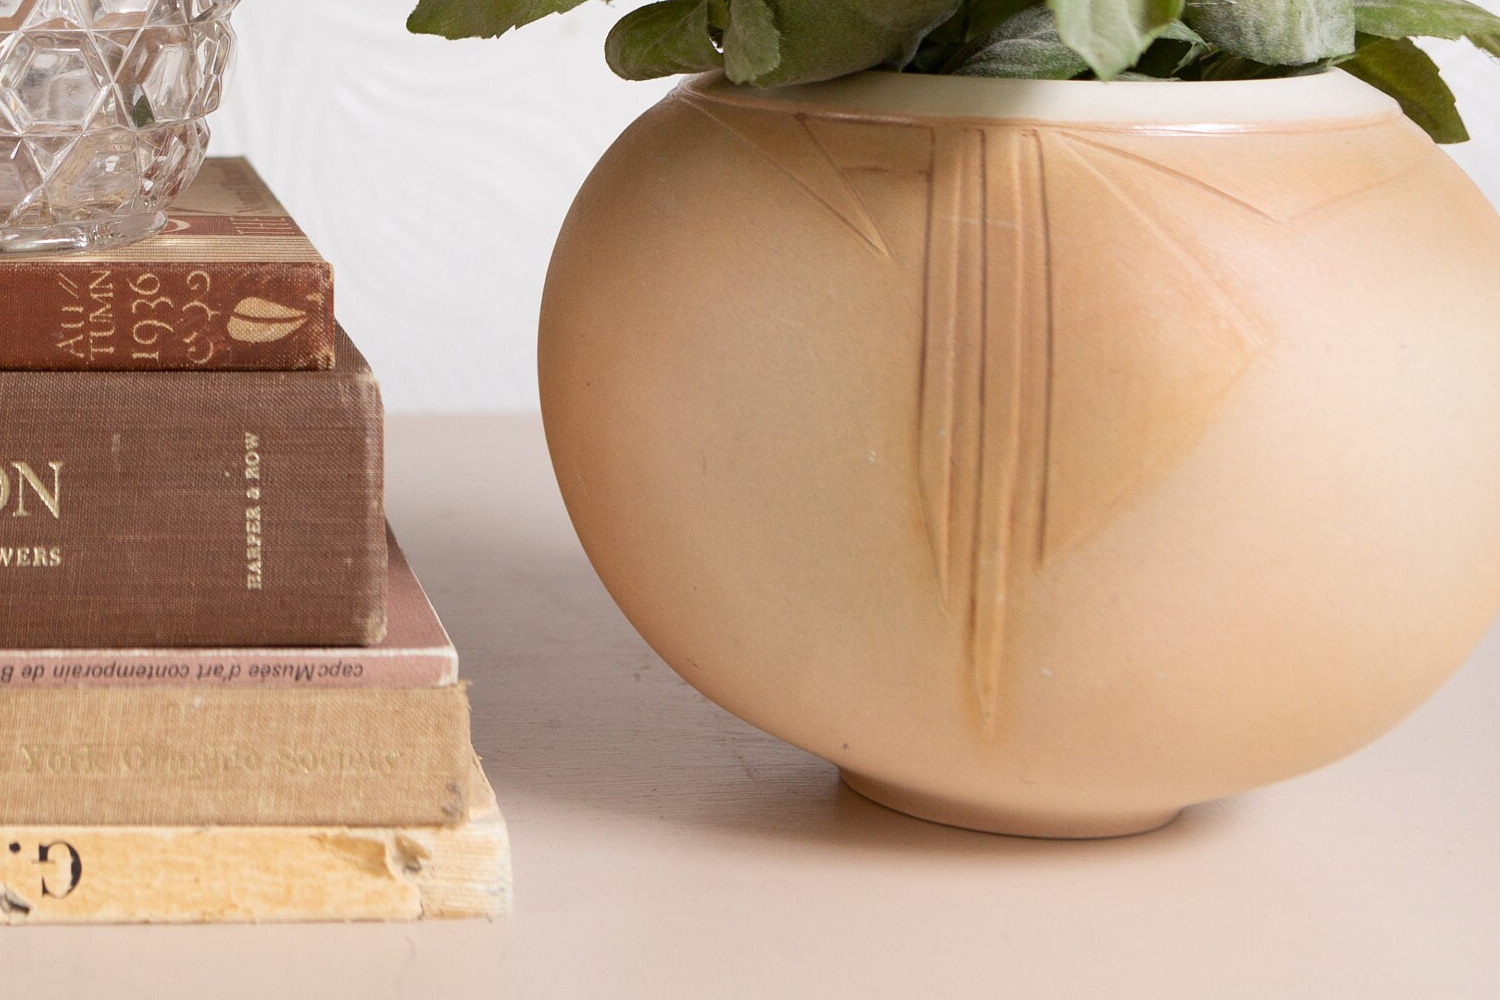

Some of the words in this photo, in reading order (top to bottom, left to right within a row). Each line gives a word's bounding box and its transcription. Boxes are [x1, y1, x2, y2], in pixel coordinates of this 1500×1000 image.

[88, 269, 116, 361] TUMN
[127, 272, 174, 363] 1936
[244, 431, 261, 480] ROW
[245, 486, 261, 500] &
[245, 505, 263, 591] HARPER
[21, 665, 45, 682] de
[53, 662, 190, 682] contemporain
[197, 665, 241, 682] d'art
[248, 664, 316, 683] Musée
[19, 743, 107, 774] York
[7, 841, 83, 899] G.
